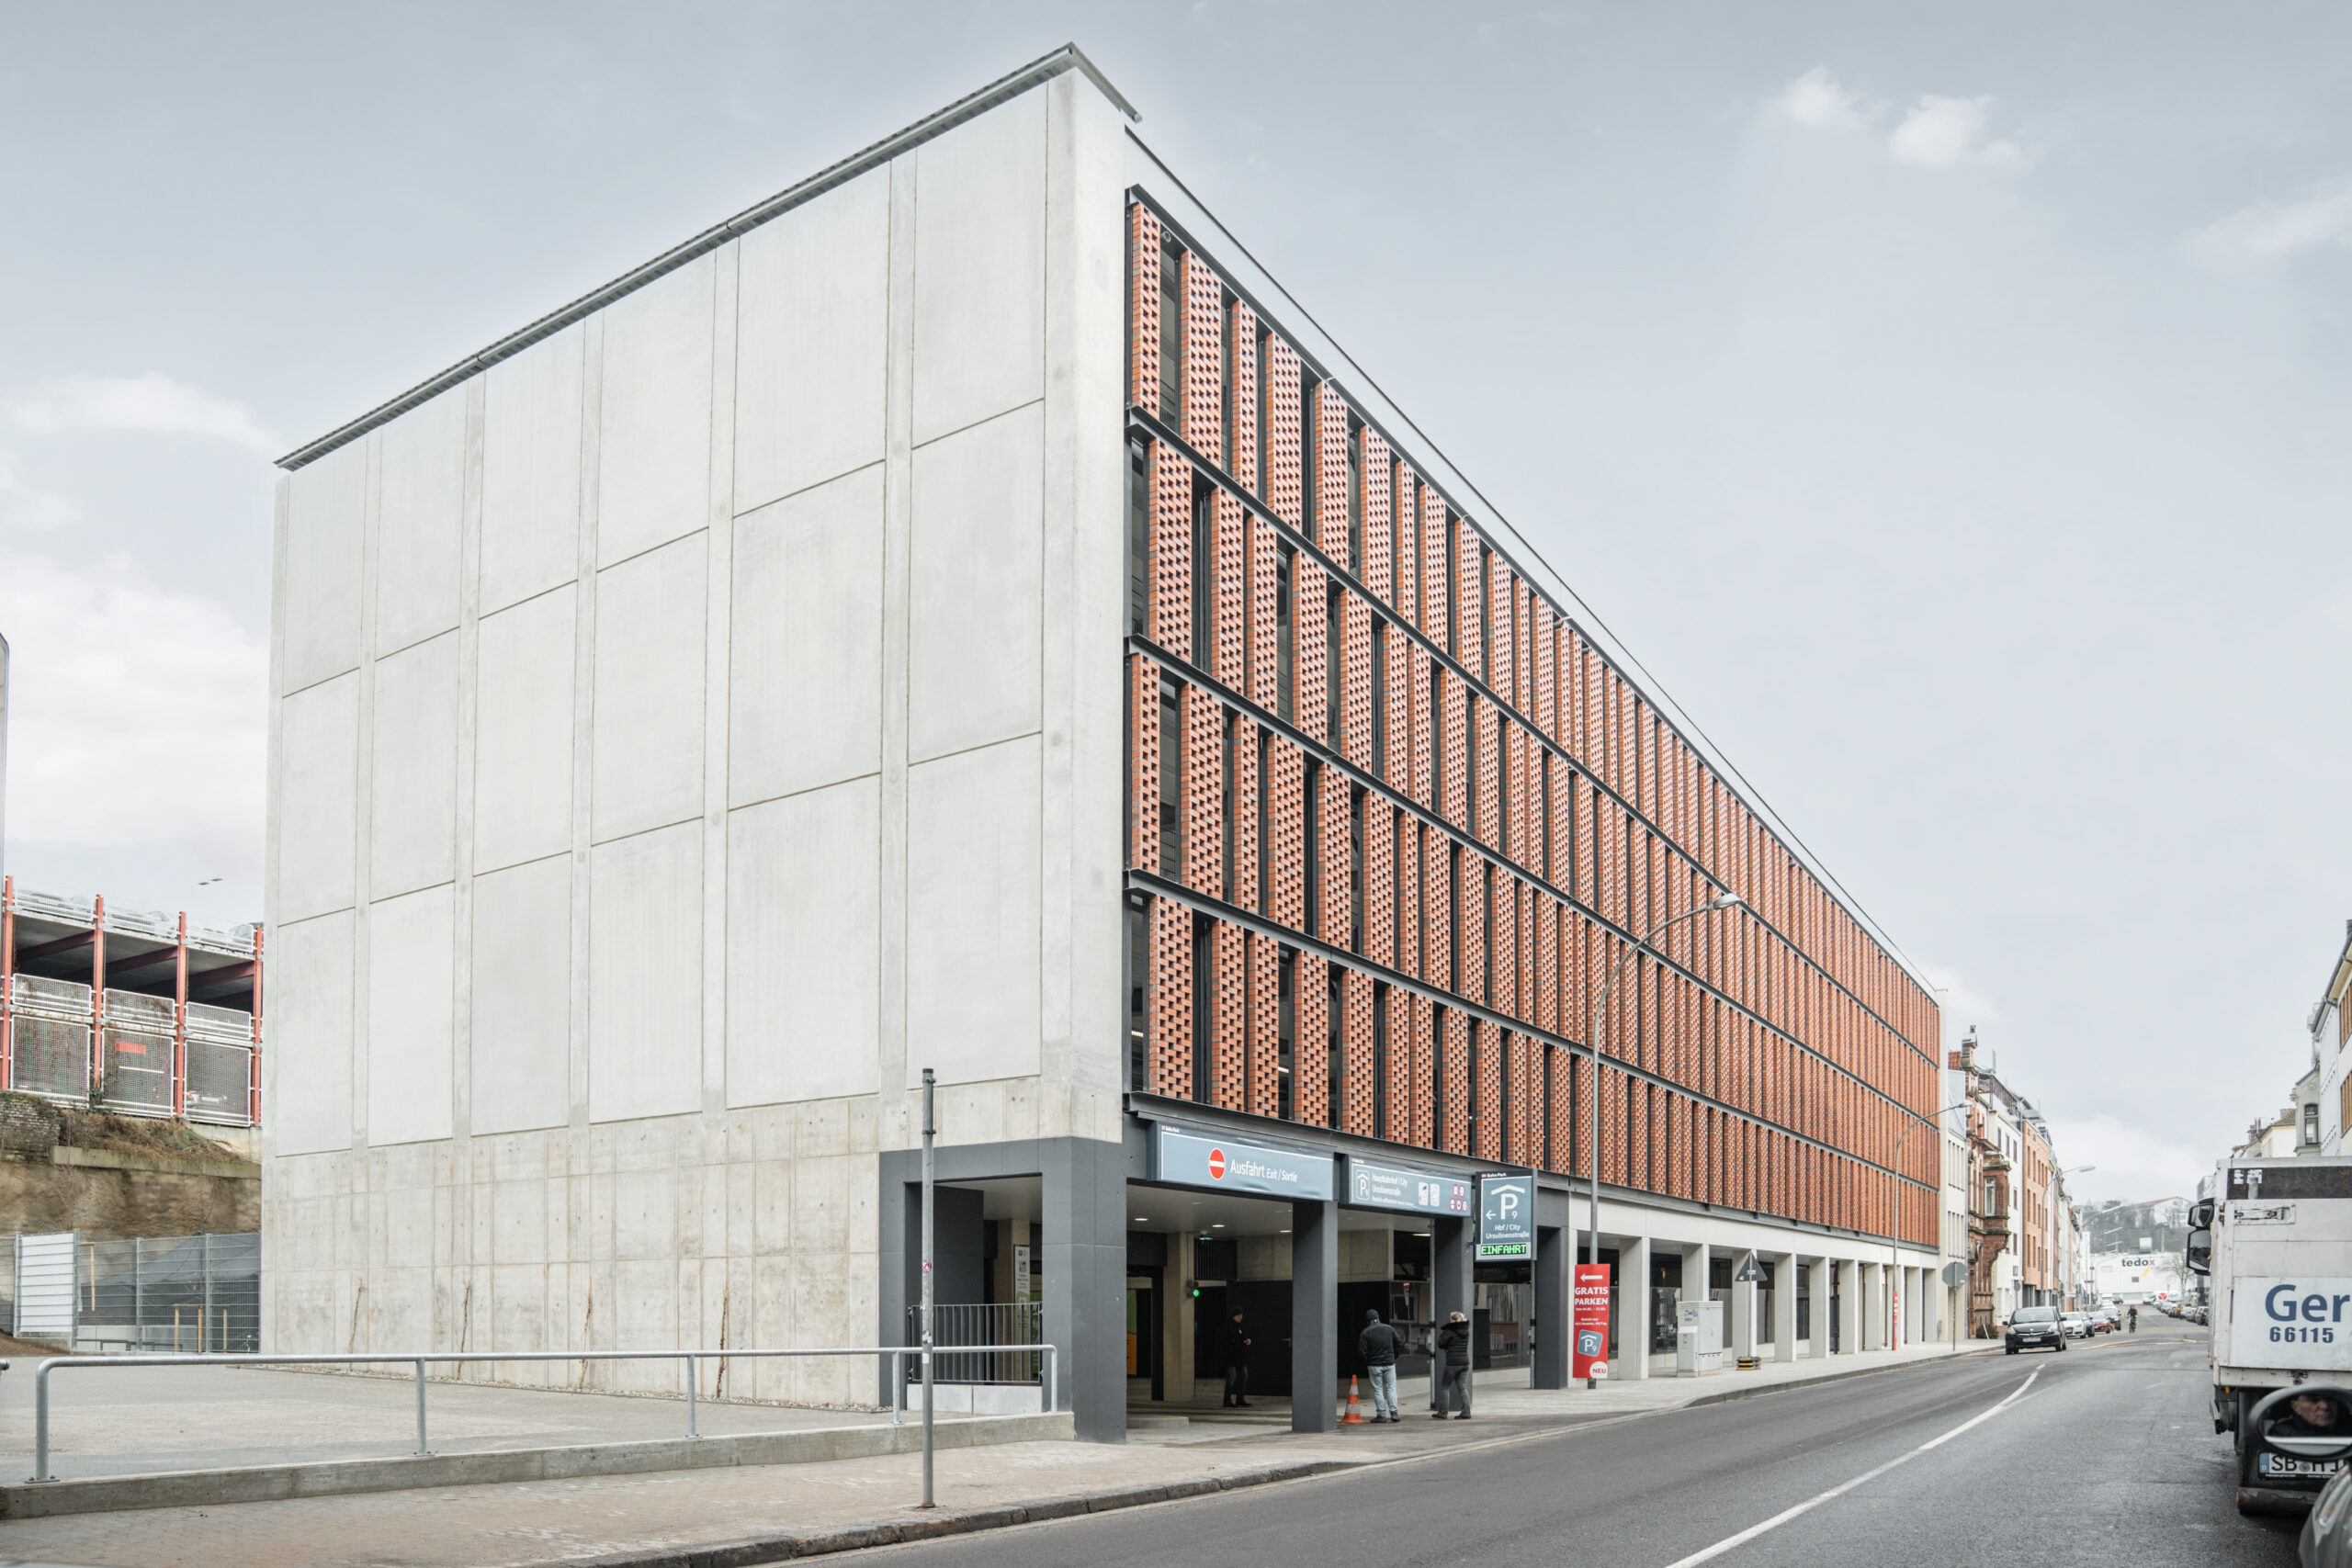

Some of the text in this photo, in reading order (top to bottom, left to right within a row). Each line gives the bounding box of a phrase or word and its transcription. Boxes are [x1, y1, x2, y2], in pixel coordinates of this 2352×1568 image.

[1229, 1159, 1265, 1178] Ausfahrt
[1266, 1168, 1278, 1179] Exit
[1282, 1170, 1298, 1182] Sortie
[1481, 1245, 1526, 1255] EINFAHRT
[2121, 1258, 2155, 1267] tedox
[1575, 1286, 1609, 1295] GRATIS
[1575, 1297, 1609, 1305] PARKEN
[2265, 1284, 2350, 1323] Ger
[2269, 1326, 2334, 1343] 66115
[2271, 1455, 2298, 1472] SB
